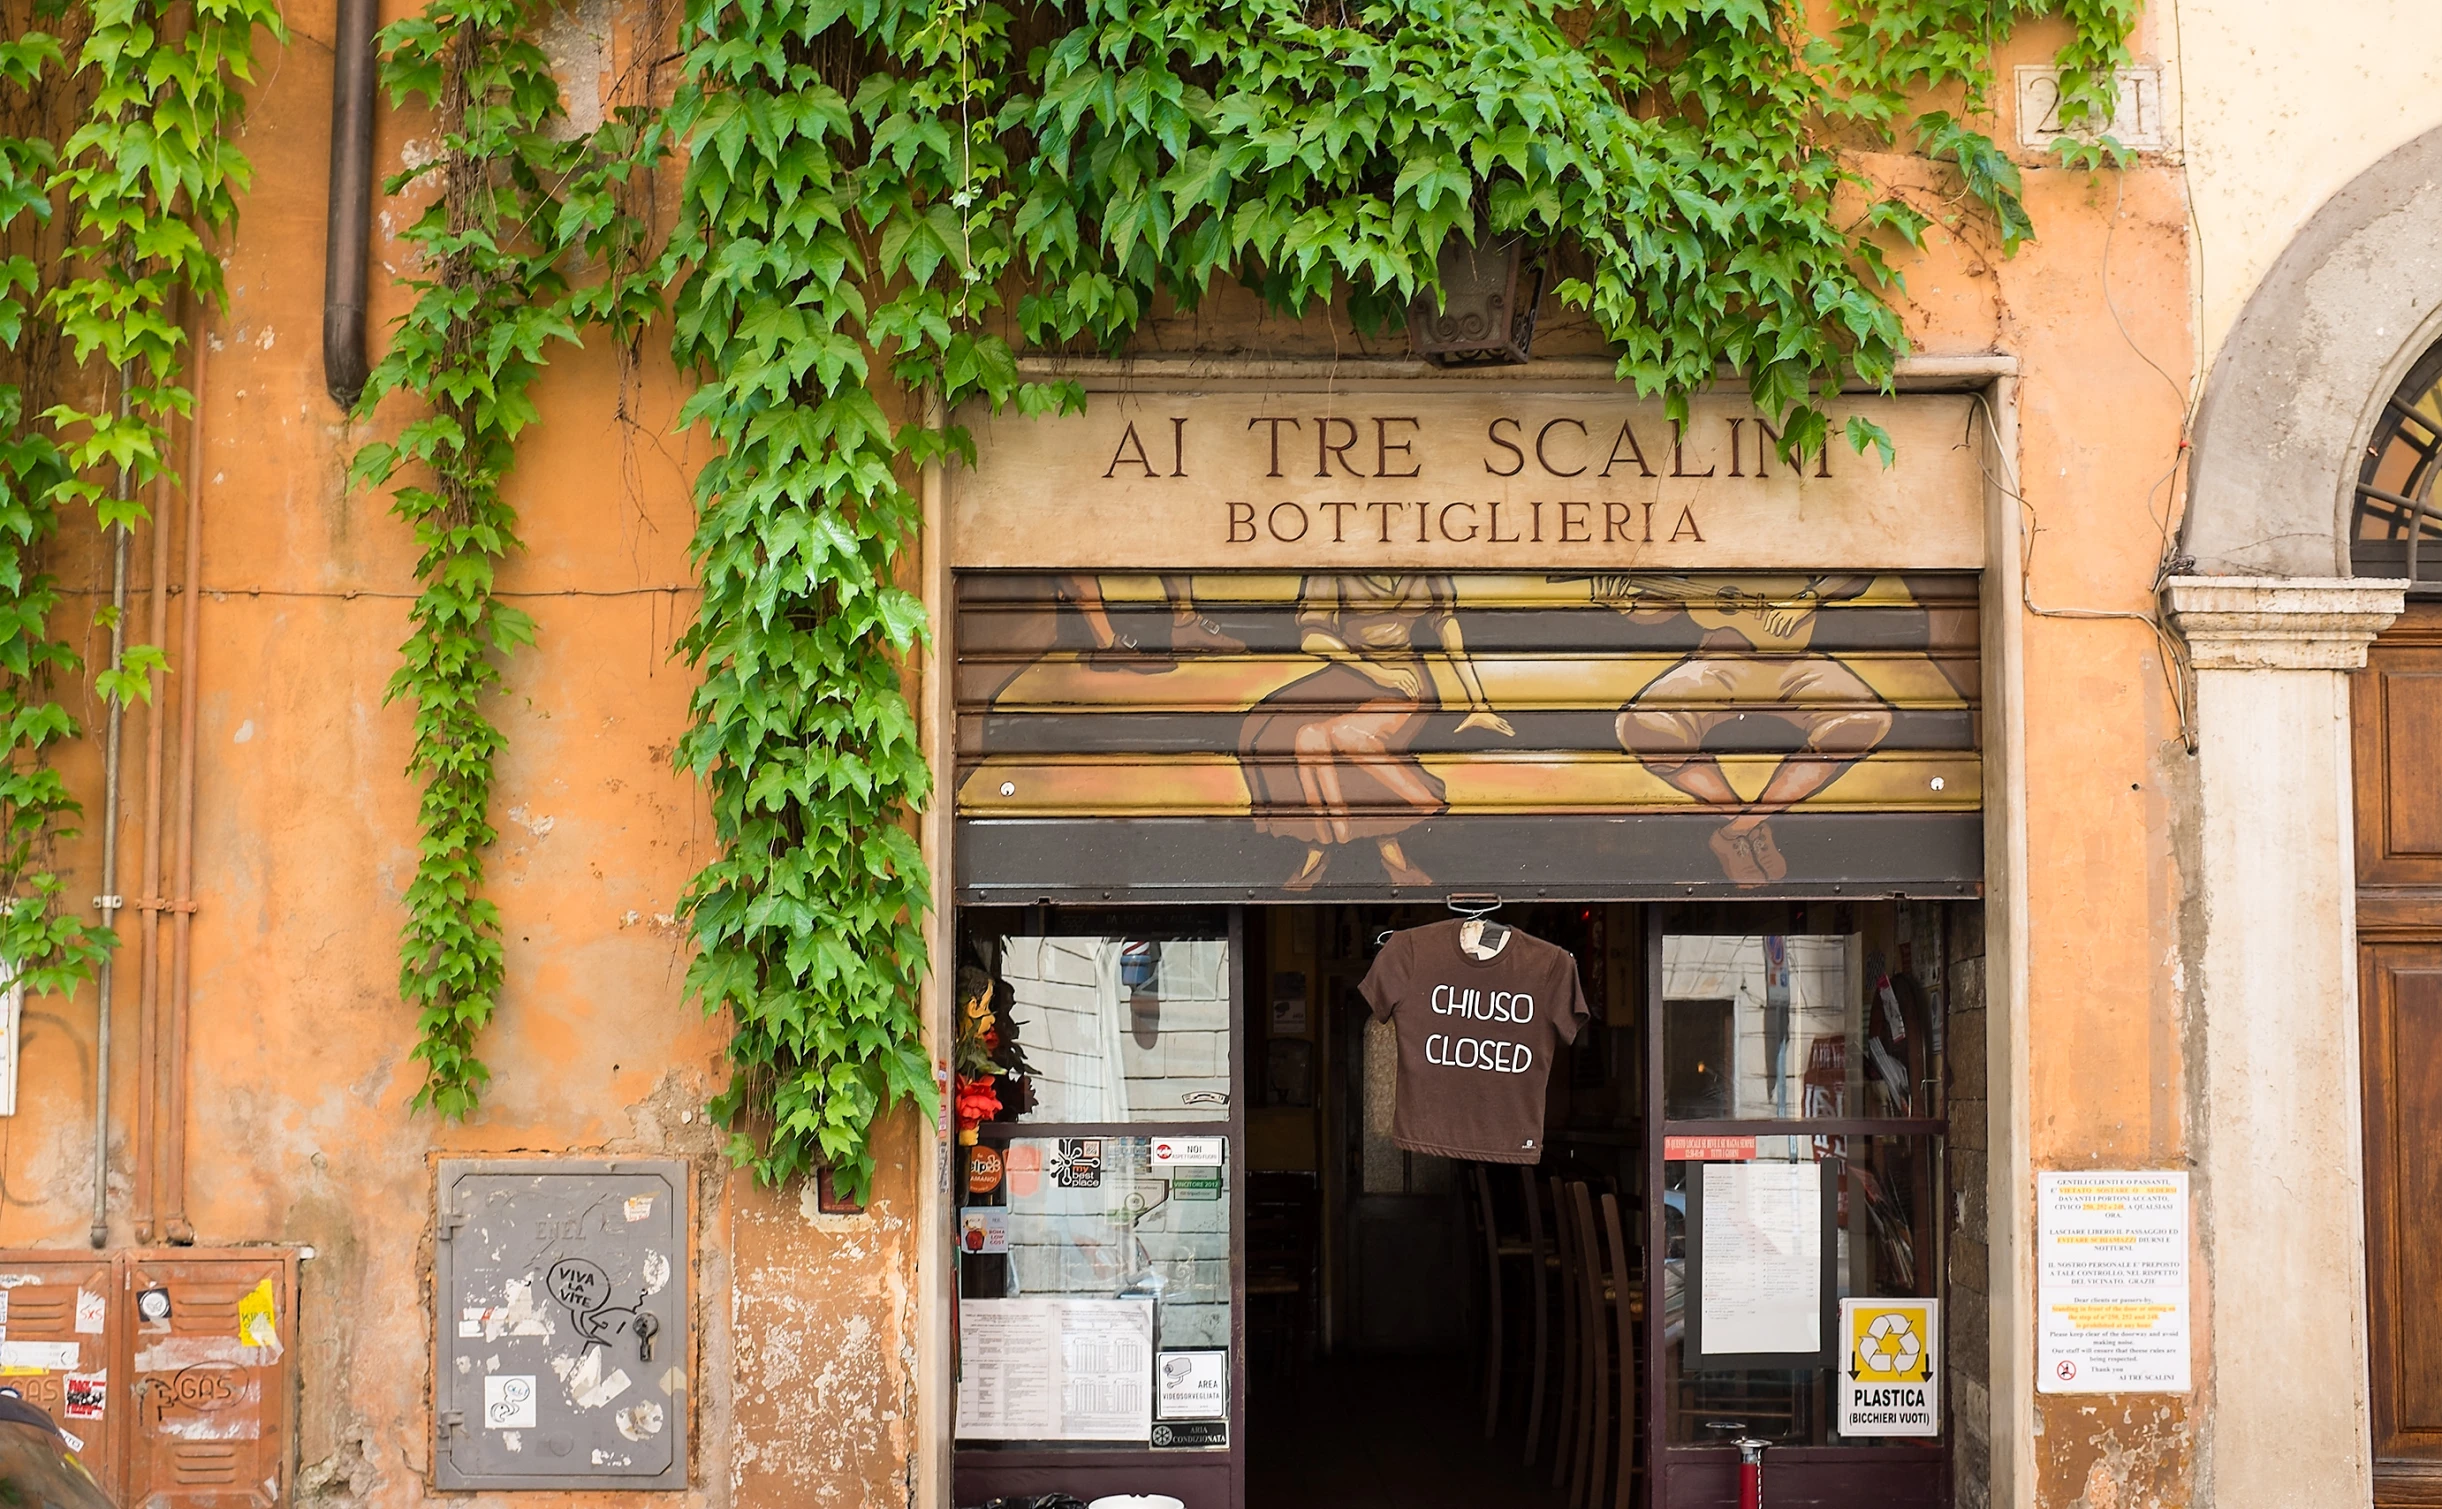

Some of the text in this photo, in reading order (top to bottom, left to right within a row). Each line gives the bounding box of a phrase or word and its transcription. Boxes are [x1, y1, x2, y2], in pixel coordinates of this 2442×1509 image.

[1101, 417, 1833, 478] AI TRE SCALINI
[1225, 501, 1706, 543] BOTTIGLIERIA
[1431, 984, 1535, 1024] CHIUSO
[1425, 1034, 1533, 1073] CLOSED
[1187, 1145, 1202, 1153] NOI
[1073, 1171, 1094, 1179] best
[1073, 1179, 1099, 1187] place
[535, 1221, 586, 1240] ENEL
[560, 1267, 594, 1286] VIVA
[568, 1282, 584, 1292] LA
[560, 1289, 592, 1308] VITE
[181, 1375, 233, 1399] GAS
[1198, 1380, 1218, 1388] AREA
[1854, 1389, 1925, 1407] PLASTICA
[1849, 1413, 1930, 1426] (BICCHIERI VUOTI)
[1172, 1434, 1226, 1443] CONDIZIONATA
